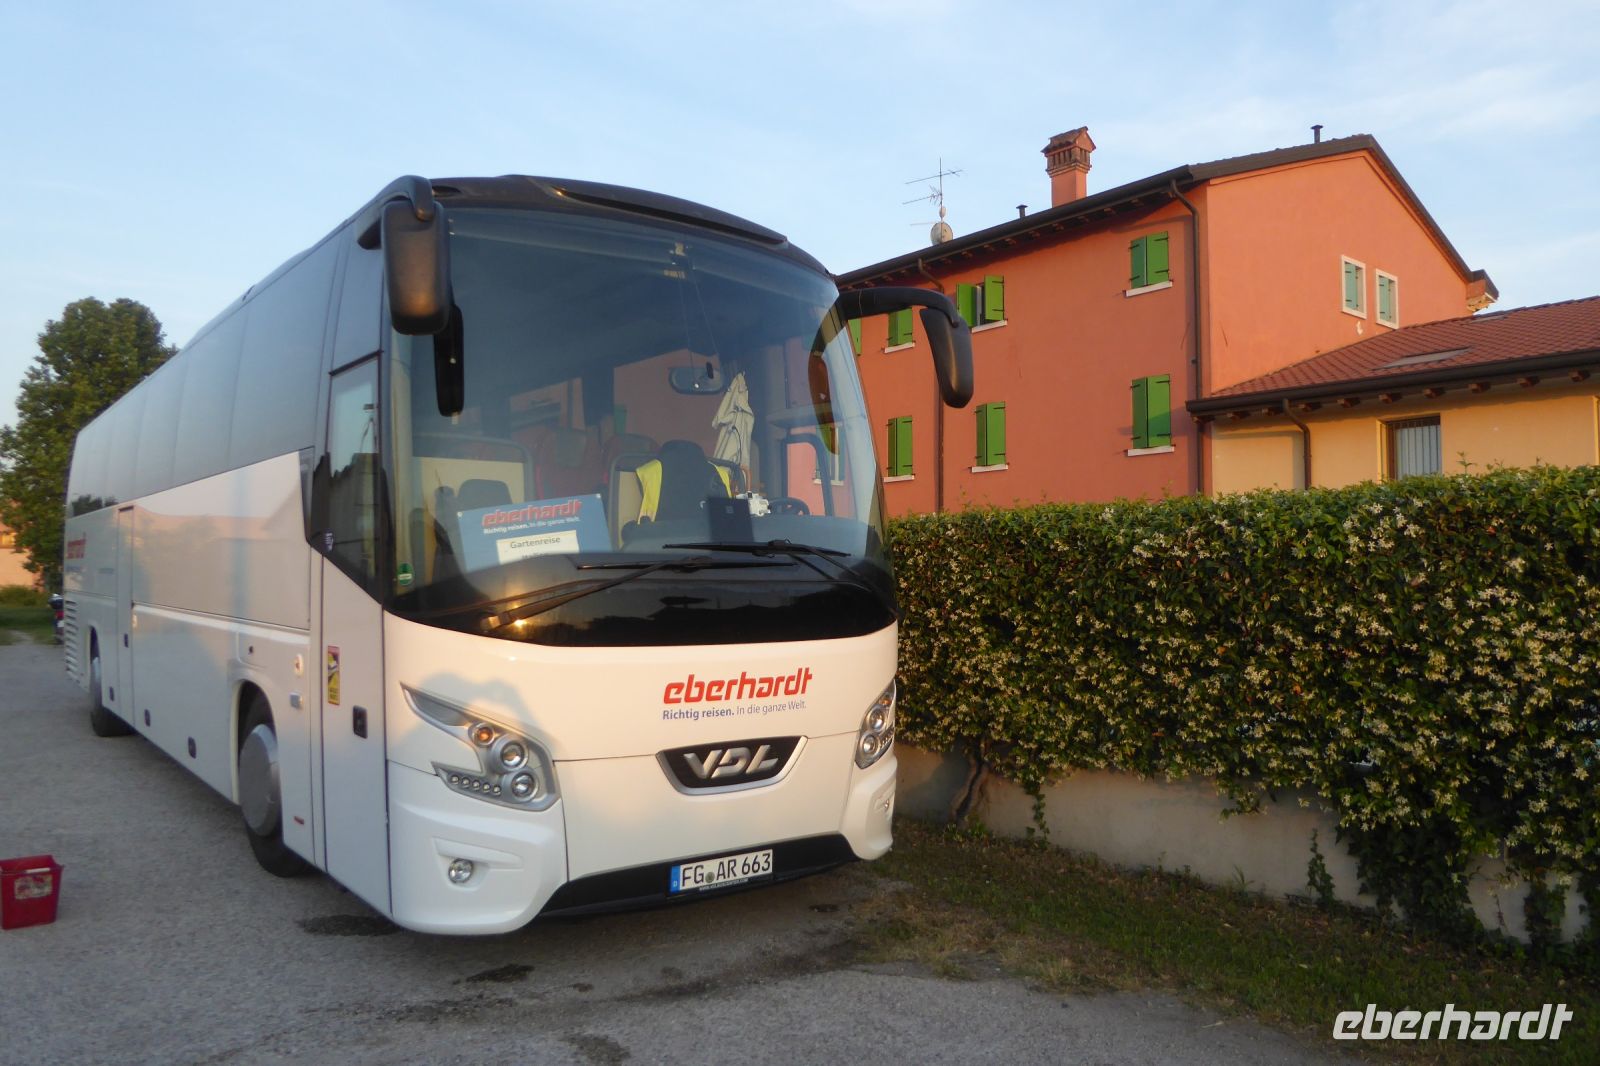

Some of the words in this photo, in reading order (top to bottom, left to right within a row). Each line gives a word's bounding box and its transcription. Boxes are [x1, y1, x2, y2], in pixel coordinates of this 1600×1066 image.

[510, 536, 561, 549] Gartenreise
[663, 667, 813, 704] eberhardt
[662, 708, 700, 721] Richtig
[702, 707, 735, 718] reisen.
[737, 706, 745, 716] In
[747, 704, 760, 714] die
[762, 702, 786, 715] ganze
[683, 744, 779, 779] VDL
[682, 864, 705, 887] FG
[716, 859, 737, 880] AR
[741, 853, 771, 876] 663
